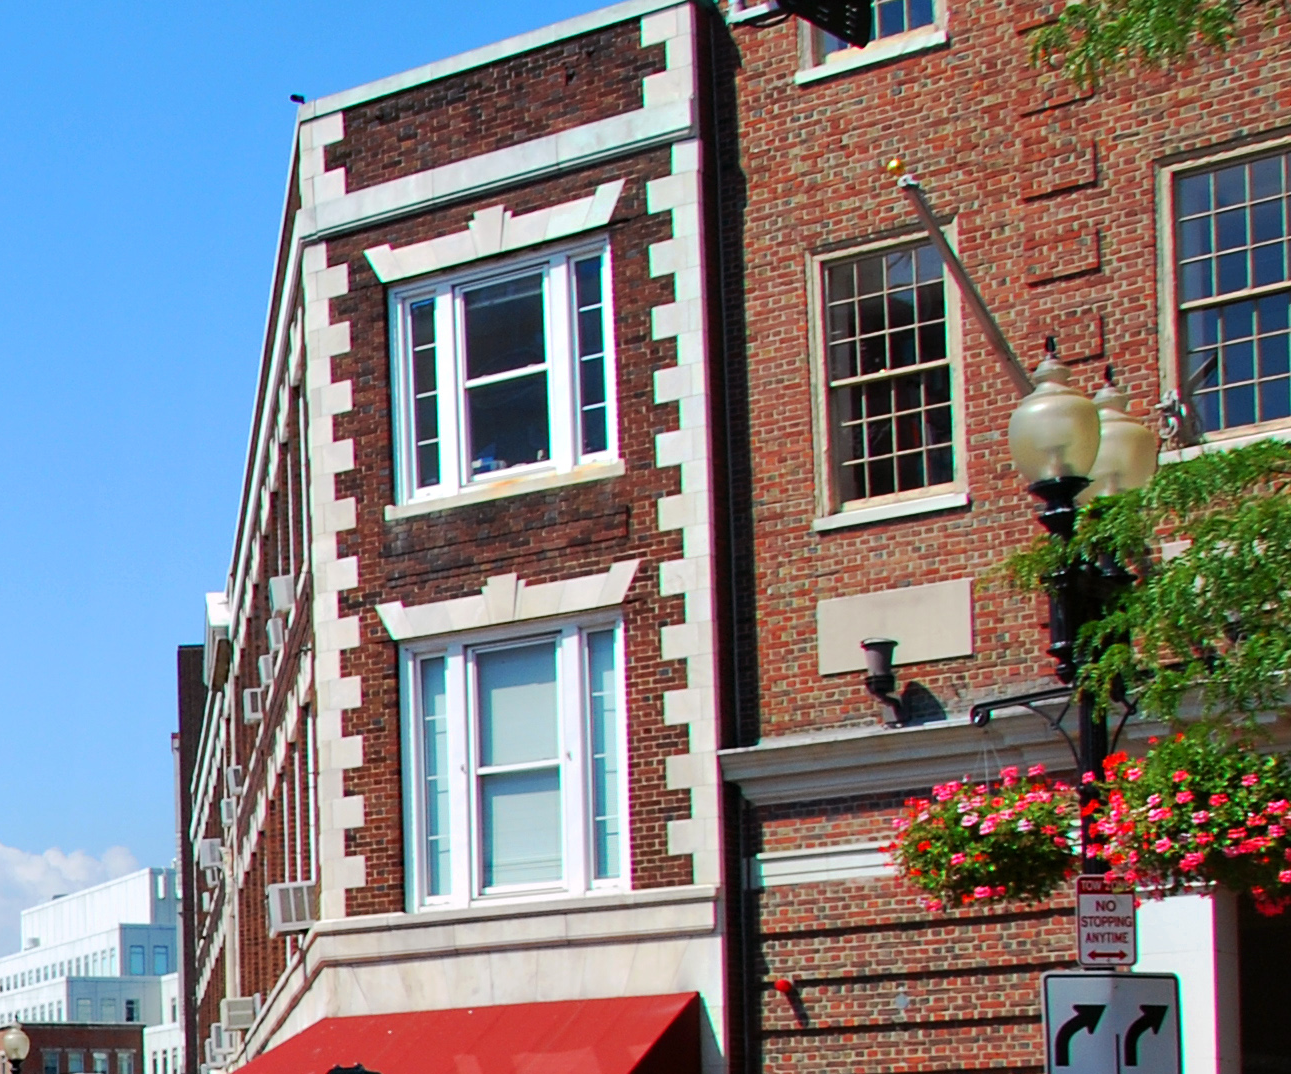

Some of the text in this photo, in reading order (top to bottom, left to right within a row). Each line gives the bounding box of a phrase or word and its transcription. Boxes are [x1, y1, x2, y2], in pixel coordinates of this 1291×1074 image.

[1082, 880, 1102, 891] TOW
[1095, 901, 1116, 912] NO
[1081, 915, 1132, 928] STOPPING
[1085, 931, 1129, 944] ANYTIME
